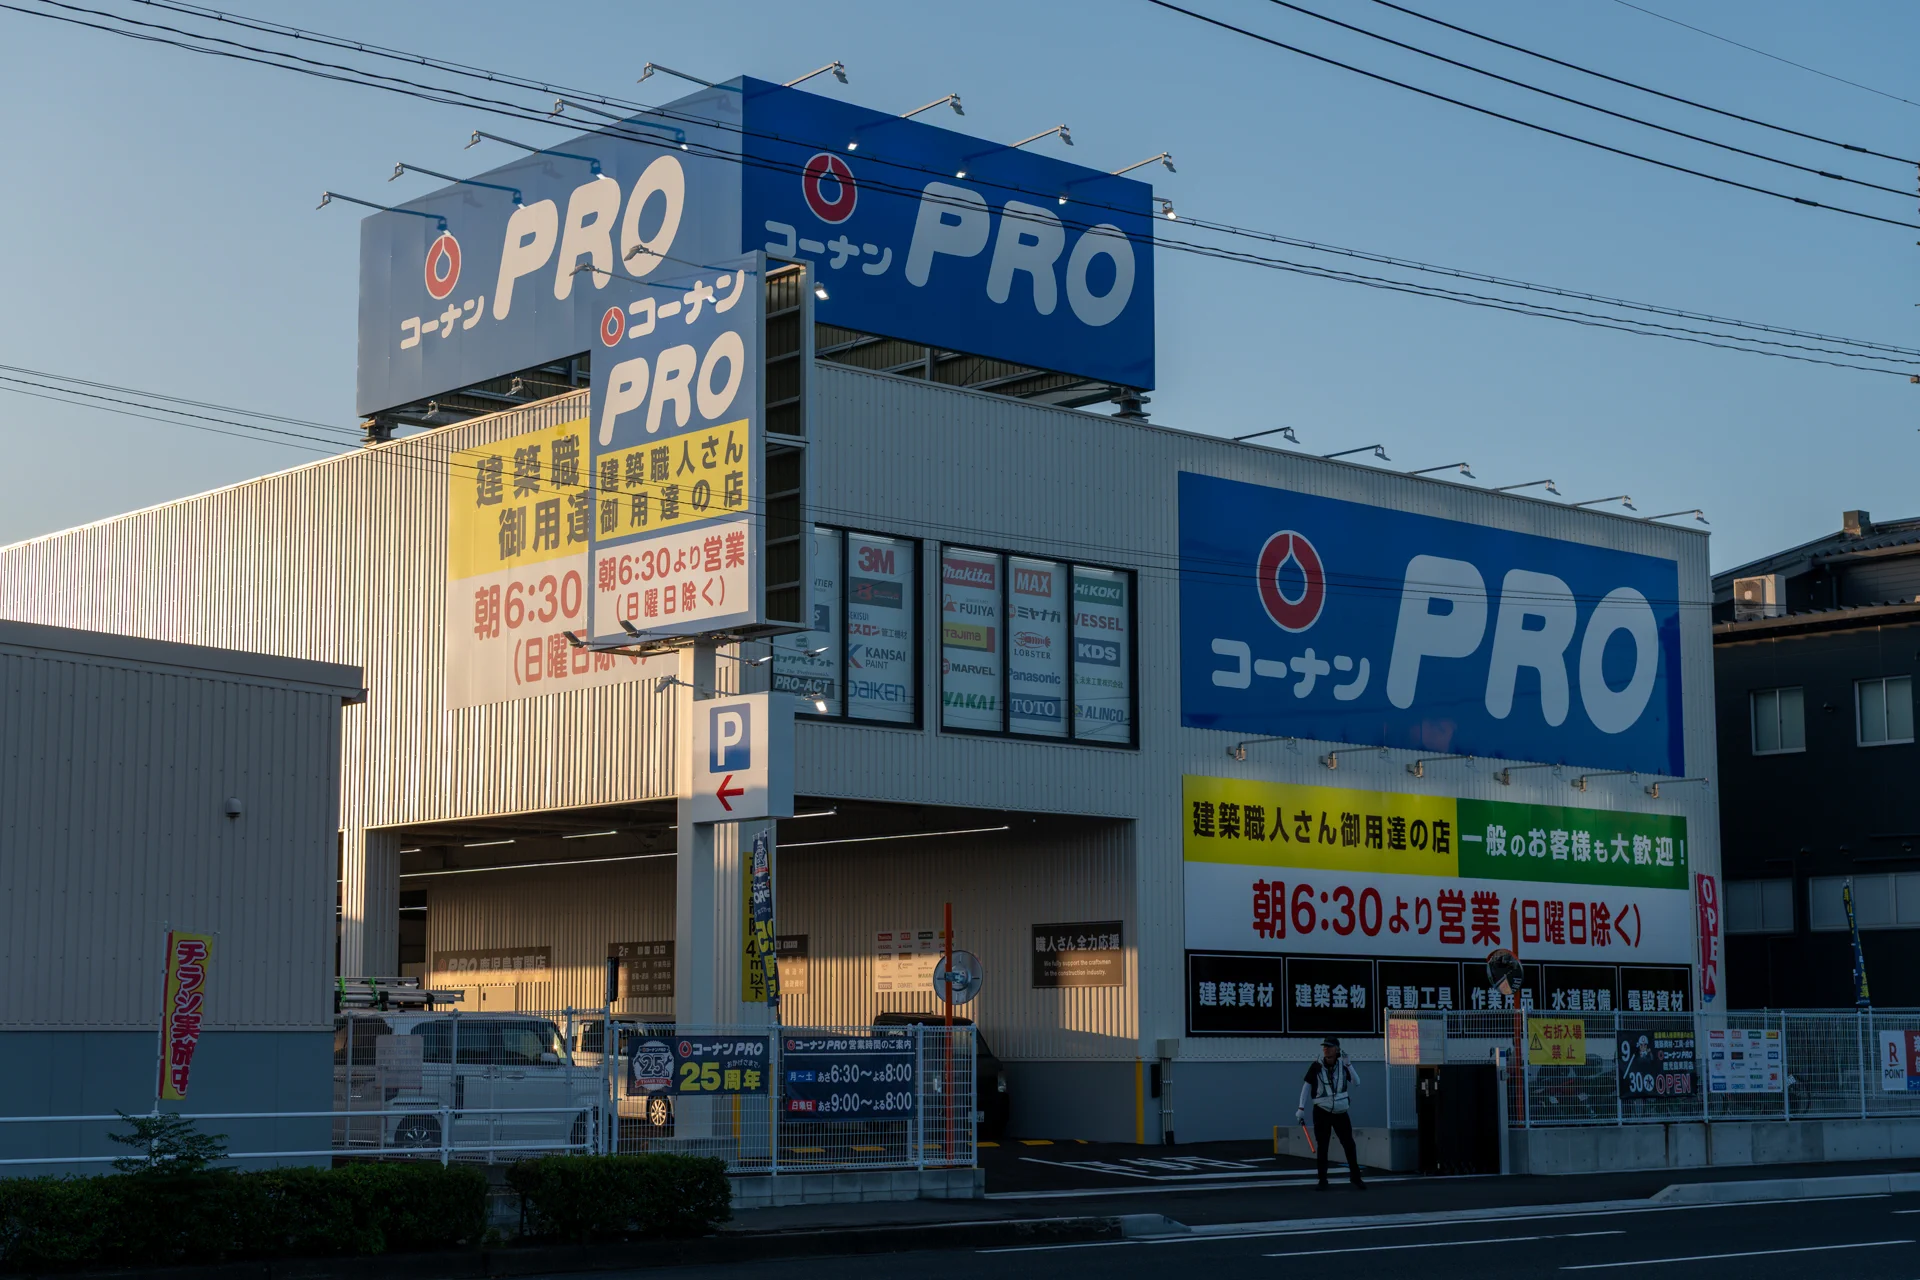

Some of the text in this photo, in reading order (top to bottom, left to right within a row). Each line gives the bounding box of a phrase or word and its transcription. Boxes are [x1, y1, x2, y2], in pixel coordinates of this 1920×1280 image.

[400, 155, 685, 350] コーナン PRO
[764, 181, 1136, 327] コーナン PRO
[628, 269, 745, 340] コーナン
[598, 330, 745, 447] PRO
[600, 430, 744, 495] 建築職人さん
[600, 470, 744, 535] 御用達の店
[498, 490, 590, 561] 御用達
[598, 530, 745, 593] 朝6:30より営業
[858, 546, 895, 575] 3M
[1017, 572, 1049, 594] MAX
[473, 570, 583, 641] 朝6:30
[616, 575, 725, 621] (日曜日除く)
[960, 602, 995, 618] FUJIYA
[1017, 606, 1061, 623] ミヤナガ
[865, 647, 906, 662] KANSAI
[1013, 648, 1051, 660] LOBSTER
[1078, 643, 1117, 662] KDS
[1211, 554, 1659, 734] コーナン PRO
[865, 659, 889, 669] PAINT
[951, 663, 995, 676] MARVEL
[774, 676, 831, 693] PRO-ACT
[1012, 698, 1055, 716] TOTO
[1085, 705, 1124, 722] ALINCO
[717, 711, 743, 768] P
[1193, 801, 1451, 855] 建築職人さん御用達の店
[1461, 823, 1685, 867] 一般のお客様も大歓迎!
[618, 945, 629, 957] 2F
[1035, 933, 1120, 953] 職人さん全力応援
[1057, 969, 1085, 977] construction
[1062, 959, 1080, 968] support
[1199, 981, 1275, 1008] 建築資材
[1295, 983, 1367, 1009] 建築金物
[1386, 985, 1453, 1009] 電動工具
[1552, 988, 1611, 1012] 水道設備
[1627, 990, 1684, 1012] 電設資材
[1543, 1024, 1582, 1040] 右折入場
[692, 1042, 764, 1056] コーナン PRO
[795, 1039, 912, 1050] コーナン PRO 営業時間のご案内
[1551, 1044, 1576, 1060] 禁止
[1889, 1042, 1899, 1063] R
[679, 1061, 761, 1091] 25周年
[1655, 1073, 1691, 1095] OPEN
[1884, 1069, 1905, 1079] POINT
